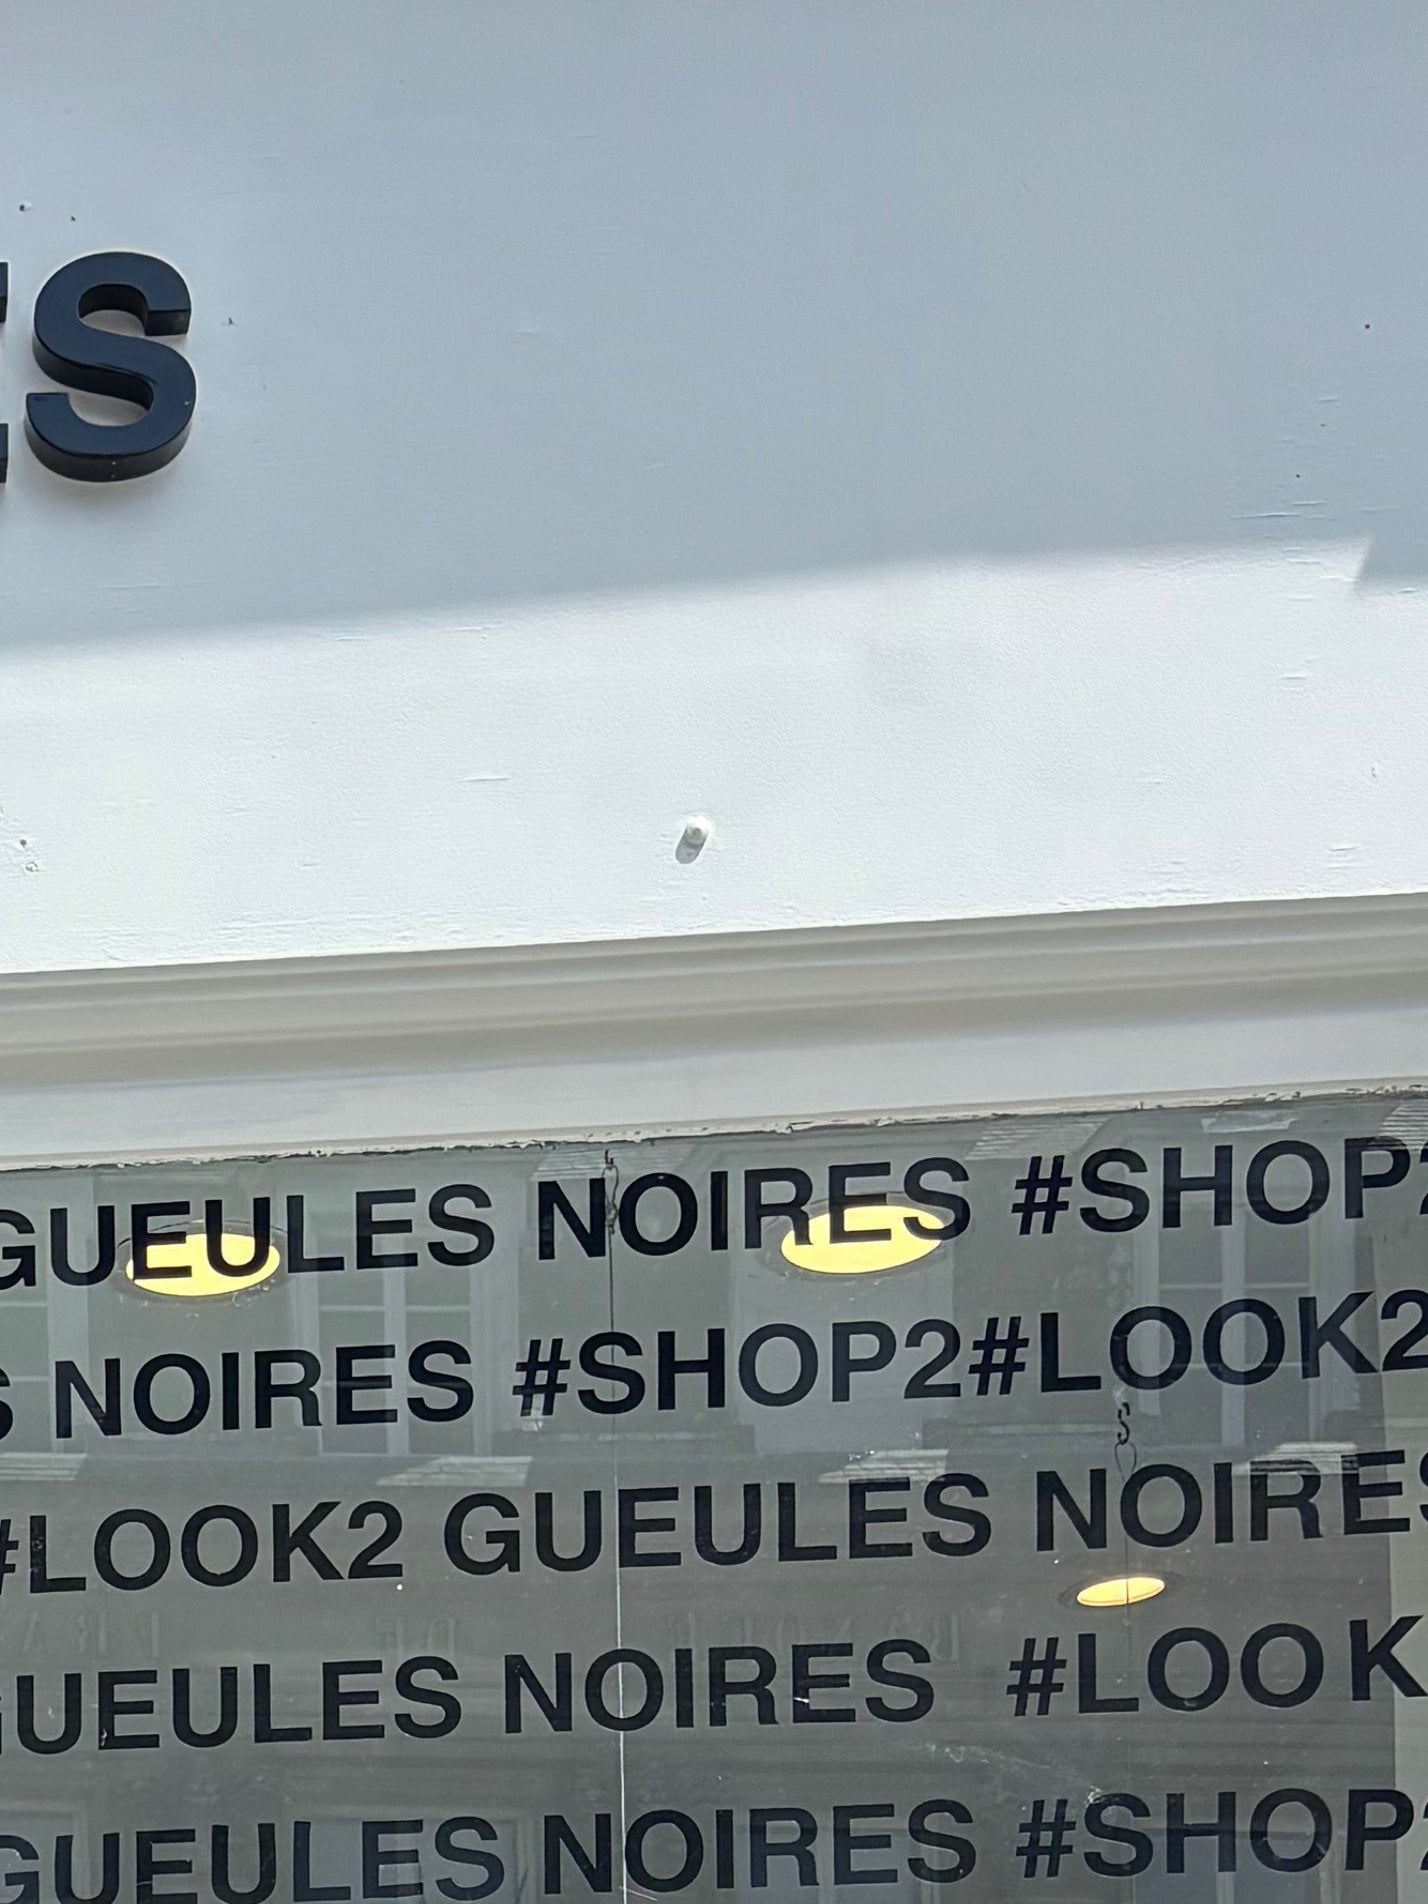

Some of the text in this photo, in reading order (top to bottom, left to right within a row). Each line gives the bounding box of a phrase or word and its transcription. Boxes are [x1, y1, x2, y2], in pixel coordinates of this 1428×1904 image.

[539, 1157, 971, 1261] NOIRES
[54, 1340, 474, 1440] NOIRES
[444, 1473, 992, 1574] GUEULES
[506, 1639, 934, 1735] NOIRES
[1008, 1614, 1428, 1718] #LOOK
[543, 1799, 977, 1896] NOIRES
